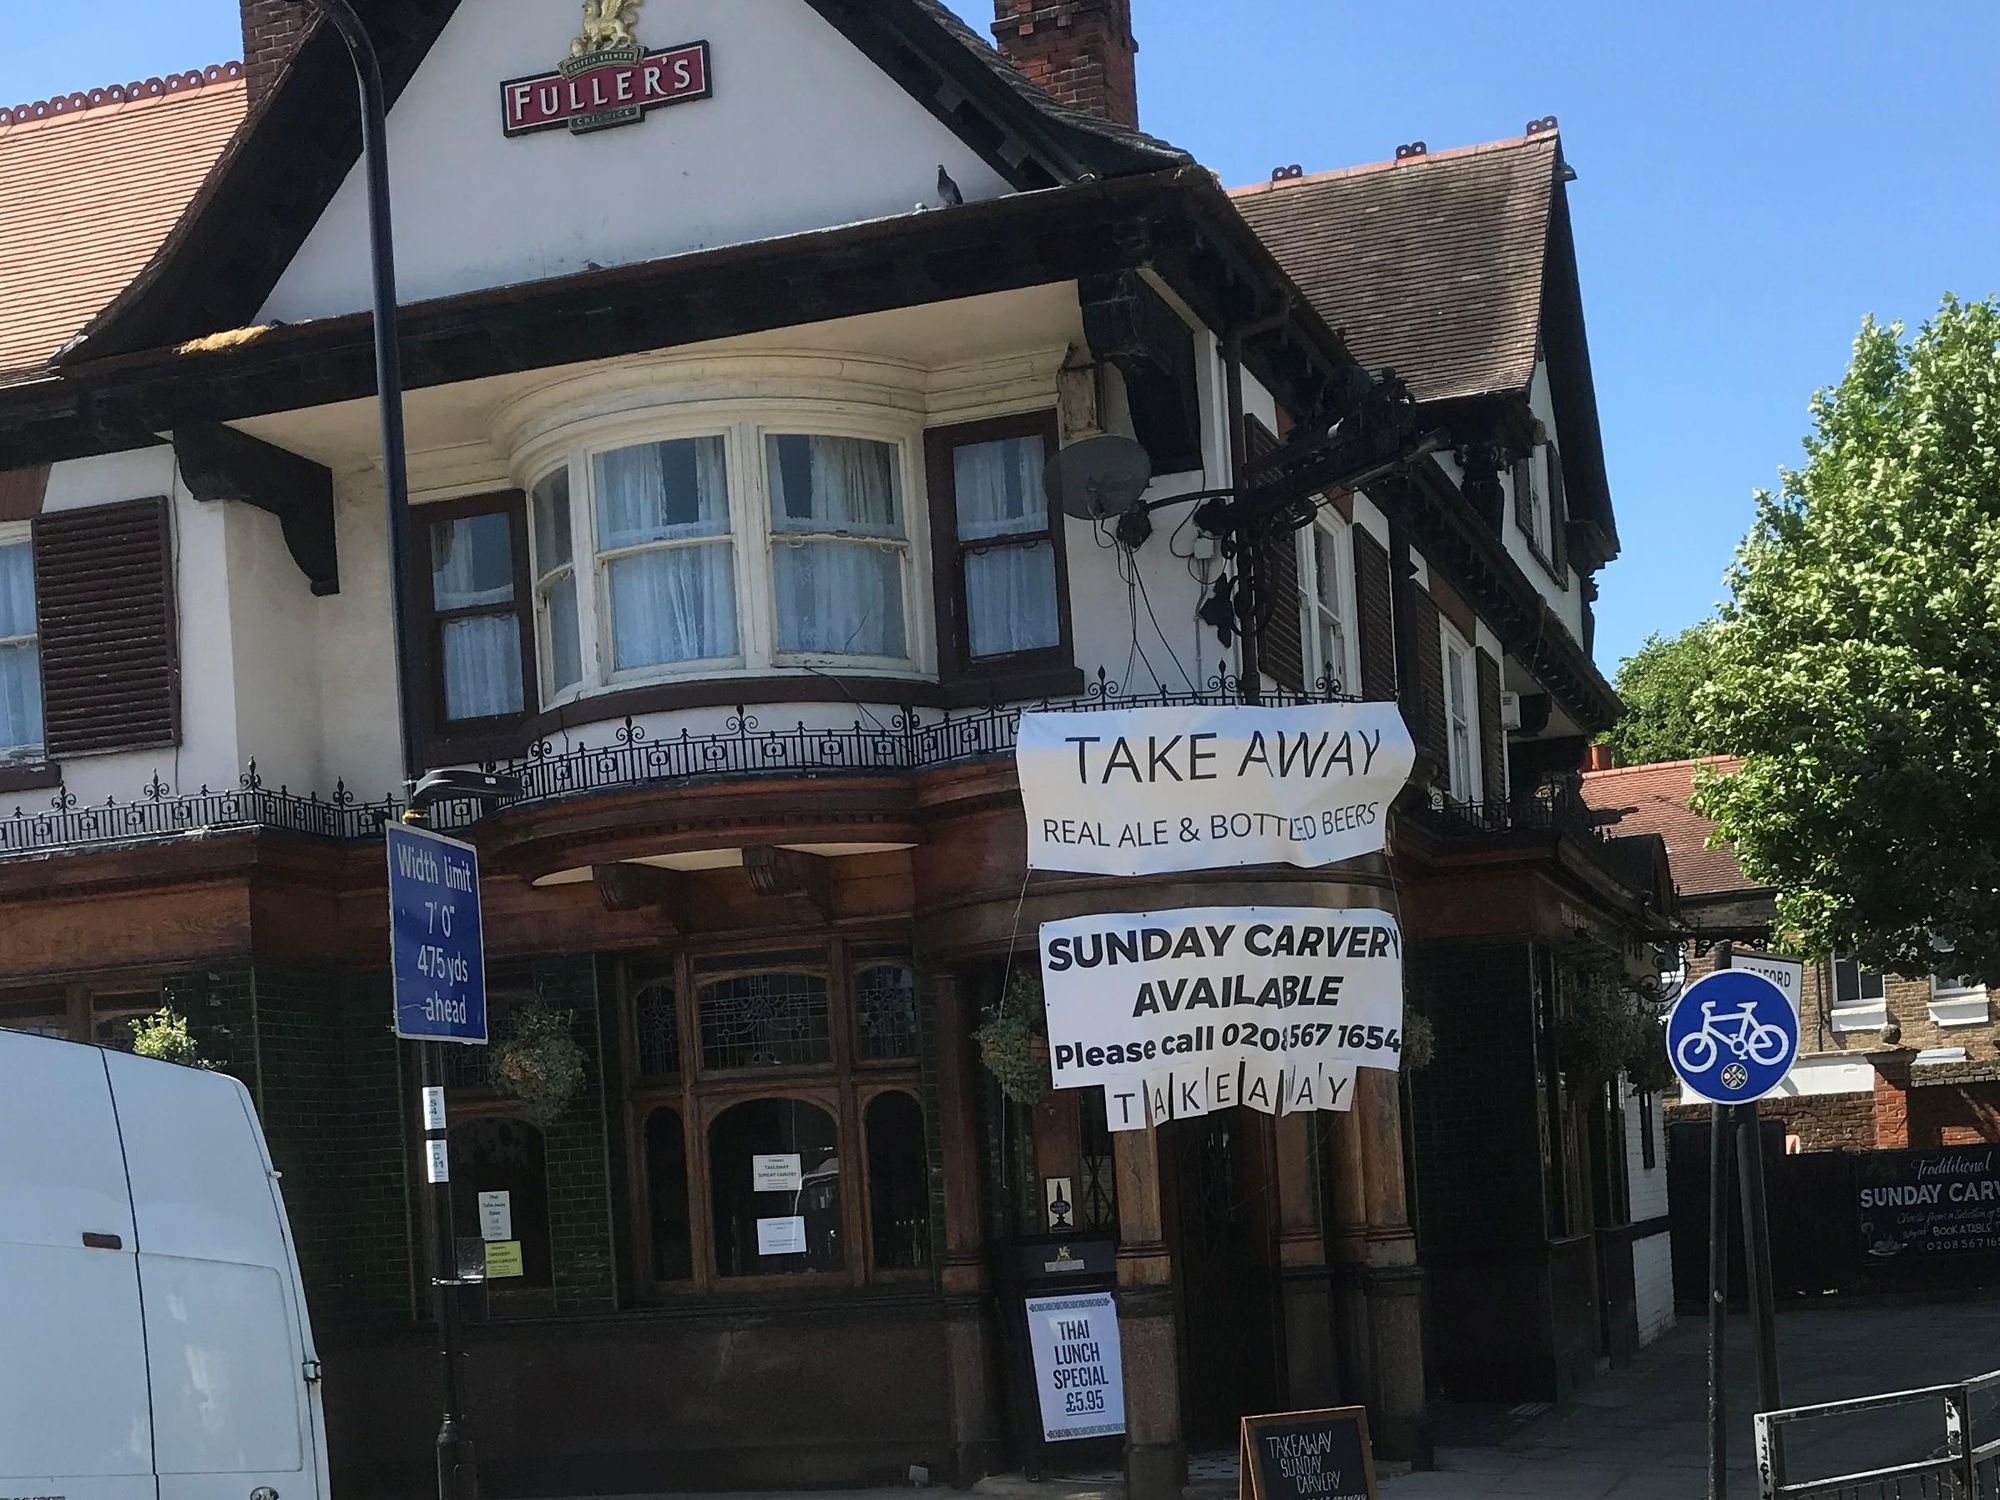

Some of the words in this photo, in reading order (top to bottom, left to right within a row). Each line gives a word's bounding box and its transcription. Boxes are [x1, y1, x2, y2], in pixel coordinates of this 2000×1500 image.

[514, 57, 691, 120] FULLER'S
[1065, 731, 1218, 784] TAKE
[1237, 728, 1381, 779] AWAY
[1043, 818, 1111, 847] REAL
[1117, 820, 1169, 848] ALE
[1178, 816, 1201, 842] &
[1210, 812, 1317, 842] BOTTLED
[1322, 801, 1379, 837] BEERS
[397, 843, 439, 885] Width
[444, 856, 472, 893] limit
[1048, 924, 1236, 972] SUNDAY
[1243, 922, 1400, 960] CARVERY
[425, 990, 467, 1025] ahead
[1132, 974, 1344, 1018] AVAILABLE
[1055, 1040, 1157, 1070] Please
[1161, 1025, 1214, 1054] call
[1289, 1023, 1333, 1048] 567
[1338, 1024, 1400, 1053] 1654
[1911, 1152, 1992, 1180] Traditional
[1860, 1184, 1942, 1209] SUNDAY
[1933, 1225, 1959, 1237] BOOK
[1057, 1319, 1090, 1341] THAI
[1054, 1342, 1100, 1366] LUNCH
[1053, 1365, 1109, 1390] SPECIAL
[1066, 1389, 1105, 1414] £5.95
[1266, 1430, 1332, 1459] TAKEAWAY
[1280, 1456, 1321, 1478] SUNDAY
[1296, 1470, 1341, 1495] CARVERY
